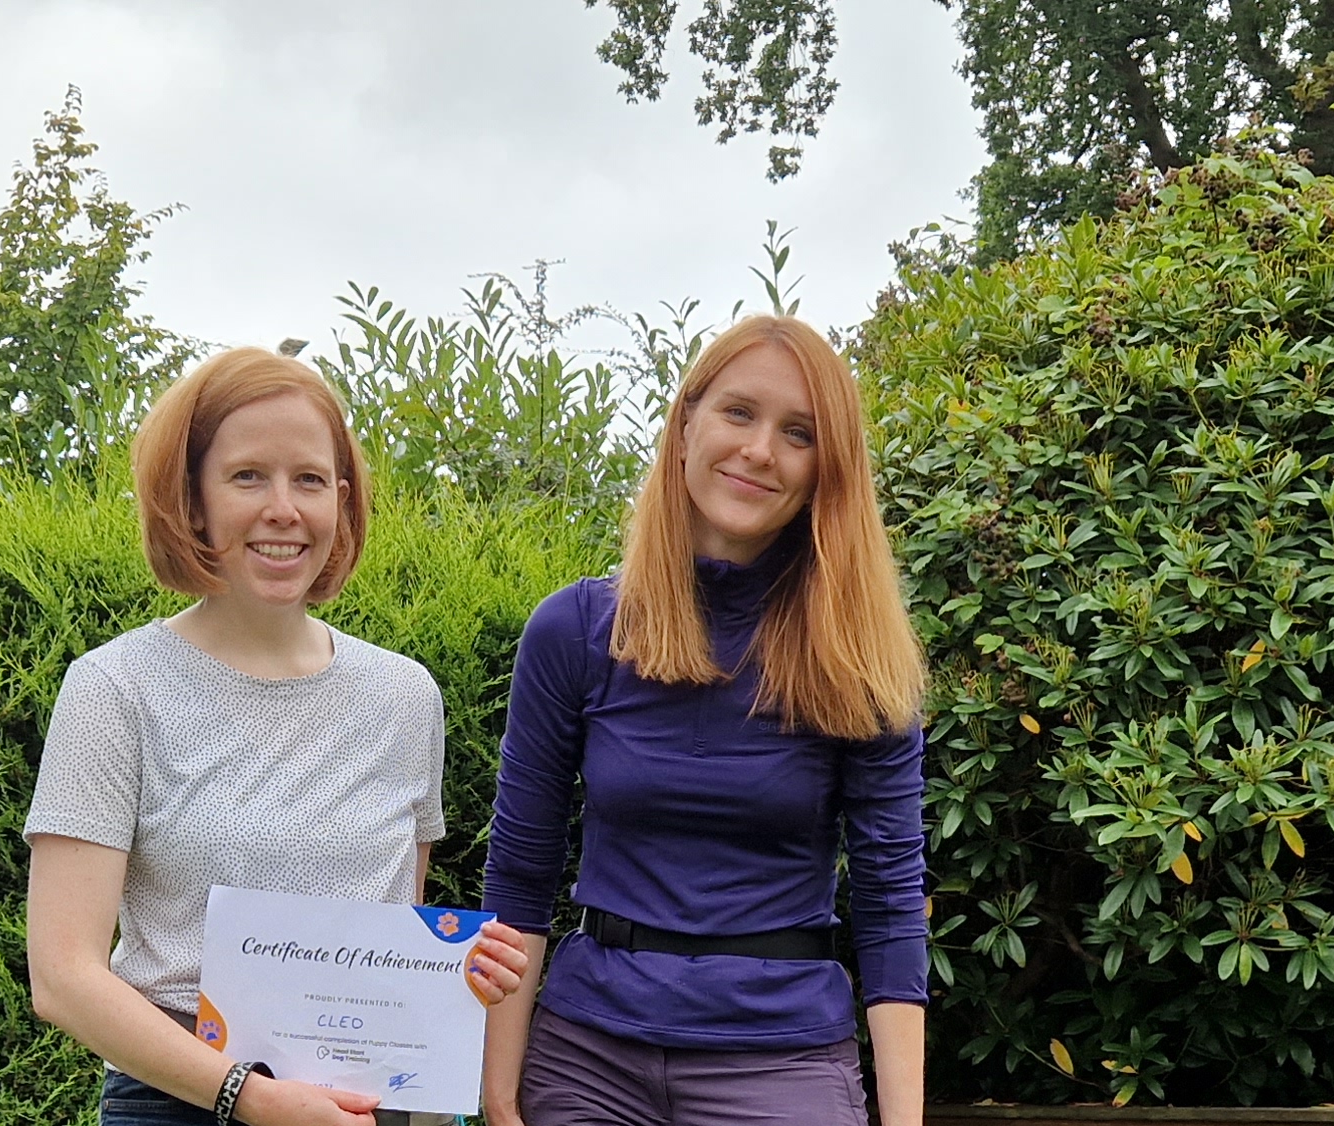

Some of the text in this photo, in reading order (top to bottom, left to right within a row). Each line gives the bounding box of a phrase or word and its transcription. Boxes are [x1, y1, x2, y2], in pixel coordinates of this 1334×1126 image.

[242, 936, 463, 975] Certificate Of Achievement
[304, 993, 342, 1003] PROUDLY
[345, 997, 390, 1007] PRESENTED
[324, 1036, 359, 1045] completion
